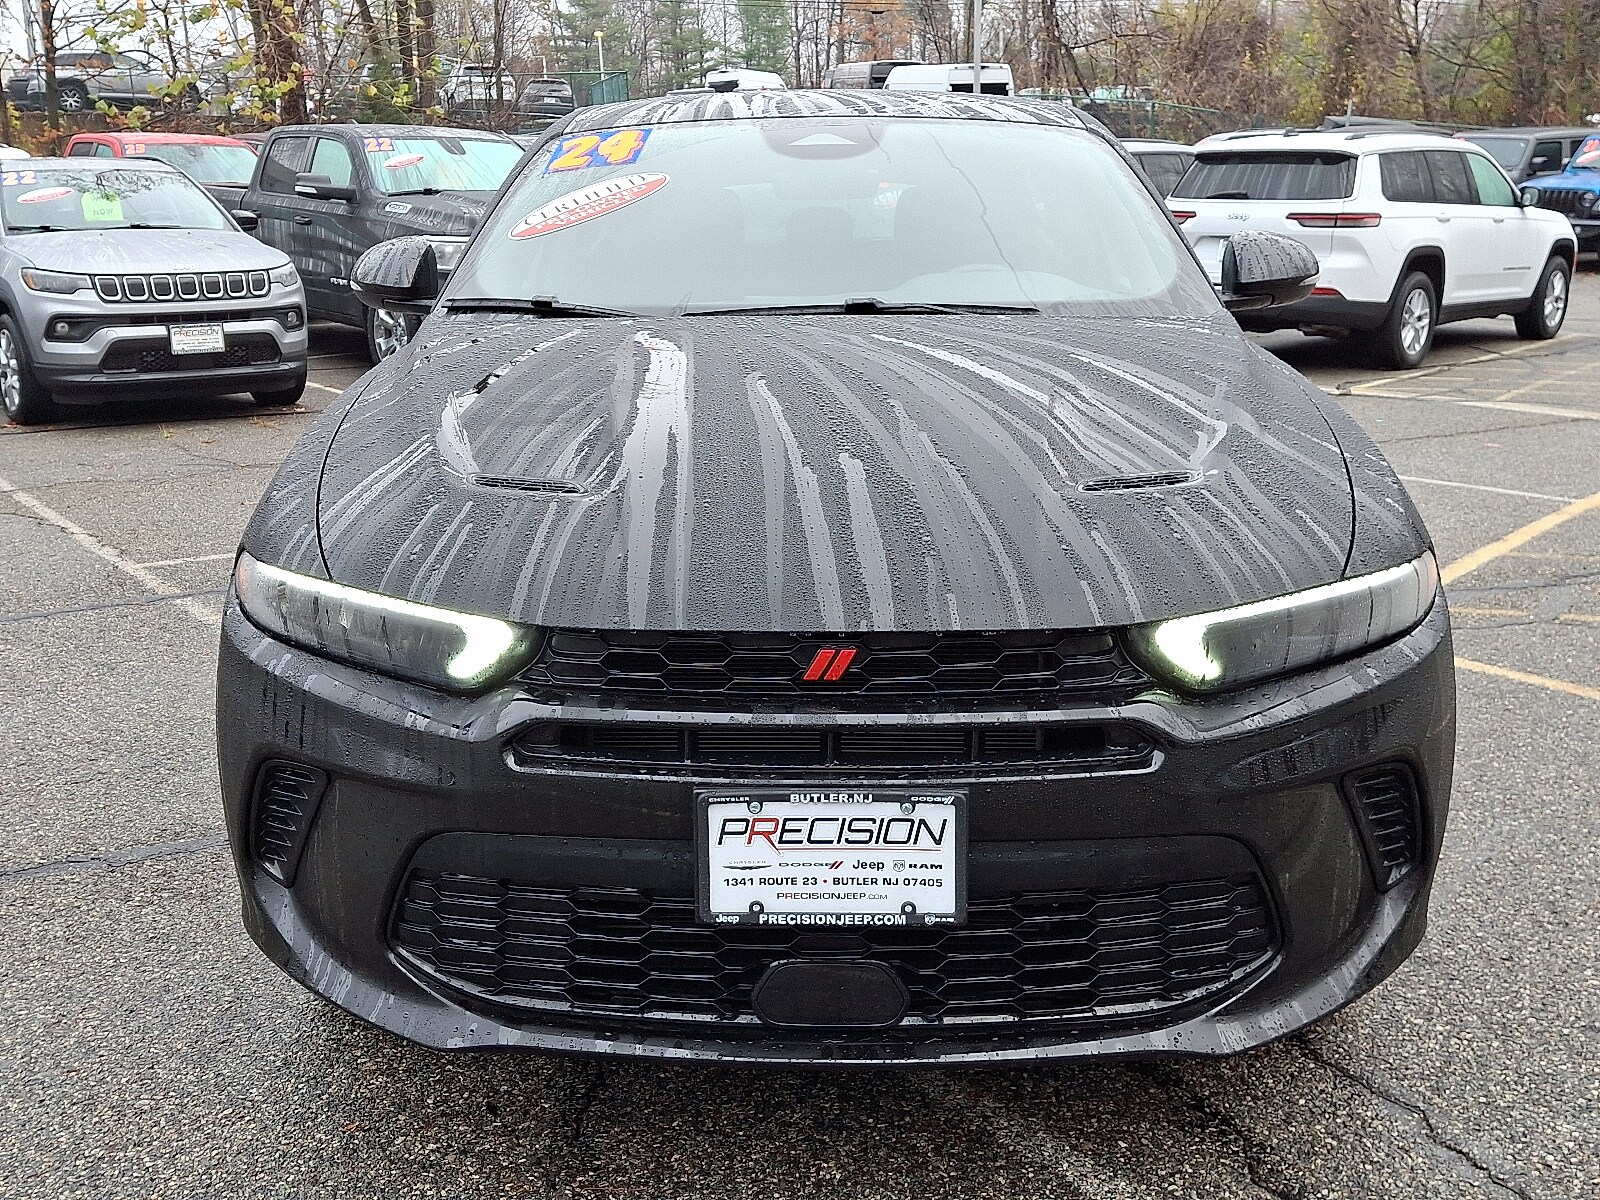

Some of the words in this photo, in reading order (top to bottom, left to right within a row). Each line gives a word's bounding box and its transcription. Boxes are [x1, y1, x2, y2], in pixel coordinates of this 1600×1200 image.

[364, 137, 394, 152] 22
[549, 129, 645, 171] 24
[1, 170, 37, 186] 22
[524, 174, 646, 226] CERTIFIED
[92, 207, 114, 217] NOW
[173, 328, 219, 337] PRECISION
[717, 817, 948, 856] PRECISION
[852, 859, 885, 871] Jeep
[723, 877, 754, 887] 1341
[758, 876, 798, 886] ROUTE
[802, 876, 818, 886] 23
[832, 876, 878, 886] BUTLER
[882, 877, 899, 886] NJ
[902, 878, 943, 888] 07405
[776, 892, 888, 900] PRECISIONJEEP.COM
[715, 914, 740, 924] Jeep
[759, 914, 907, 925] PRECISIONJEEP.COM
